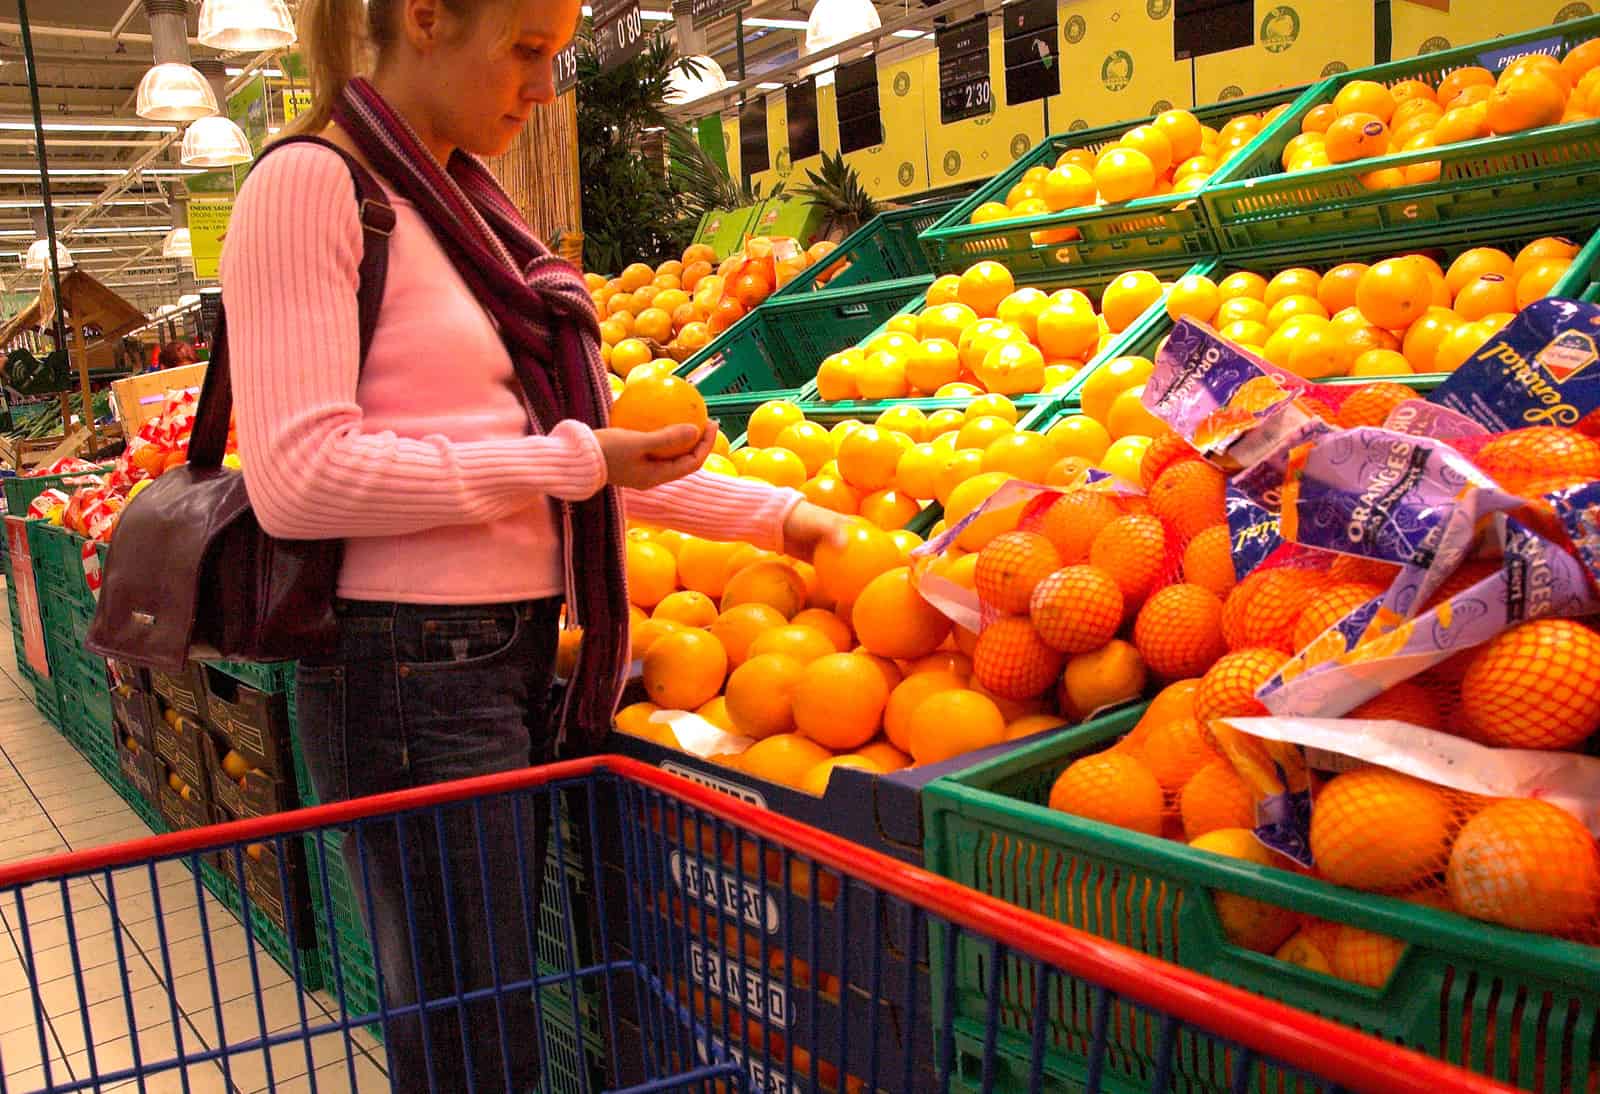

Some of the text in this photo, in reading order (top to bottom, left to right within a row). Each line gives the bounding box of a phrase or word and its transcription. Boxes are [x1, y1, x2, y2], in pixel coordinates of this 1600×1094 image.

[617, 6, 641, 48] 0'80
[965, 80, 990, 108] 2'30
[1347, 441, 1412, 544] ORANGES
[1507, 529, 1552, 617] RANGES
